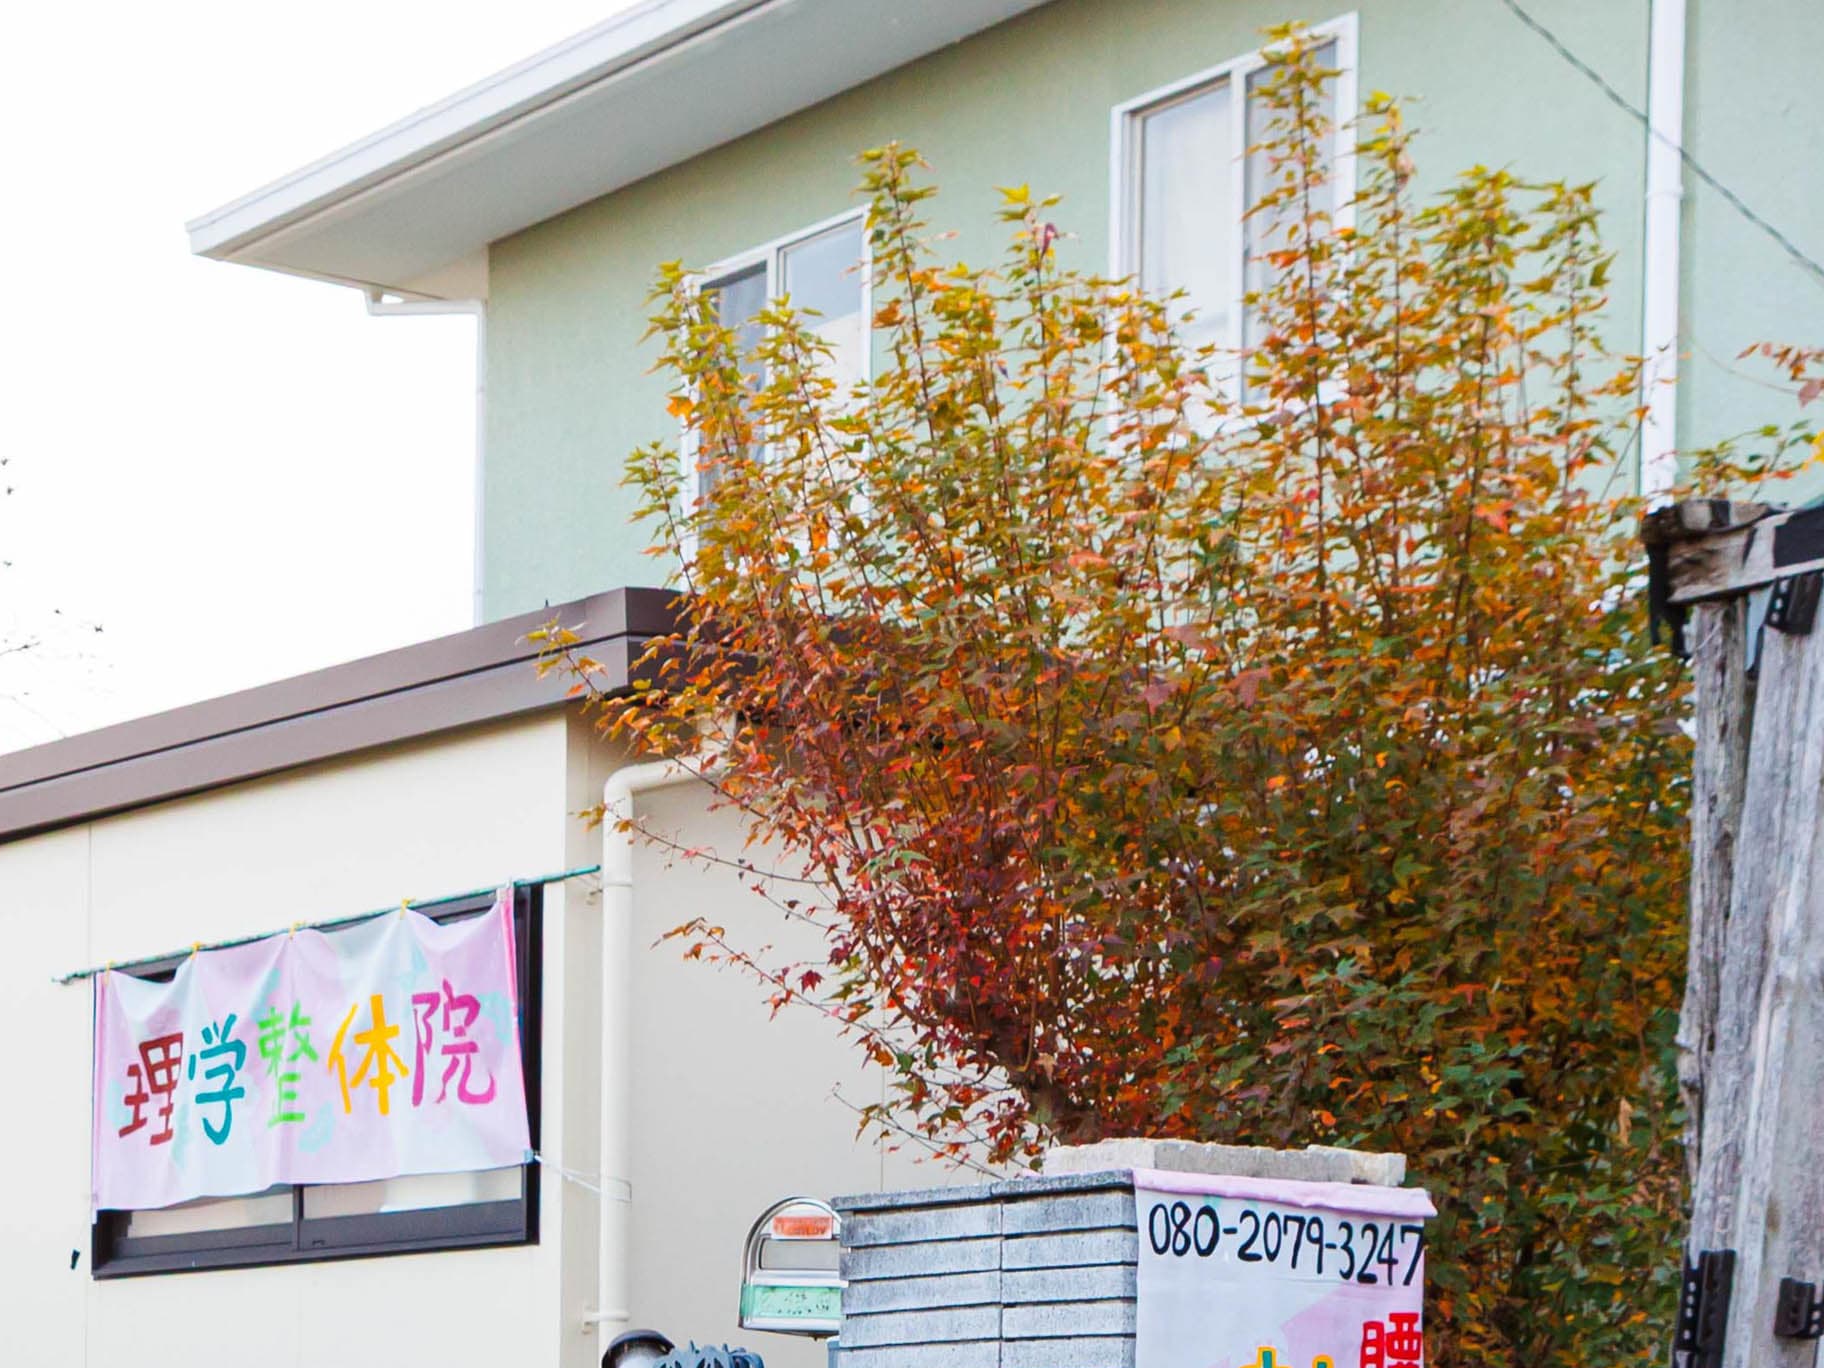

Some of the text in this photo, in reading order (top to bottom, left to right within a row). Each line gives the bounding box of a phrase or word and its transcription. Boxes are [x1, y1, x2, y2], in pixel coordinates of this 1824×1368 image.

[118, 977, 496, 1146] 理学整体院
[1149, 1201, 1423, 1286] 080-2079-3247
